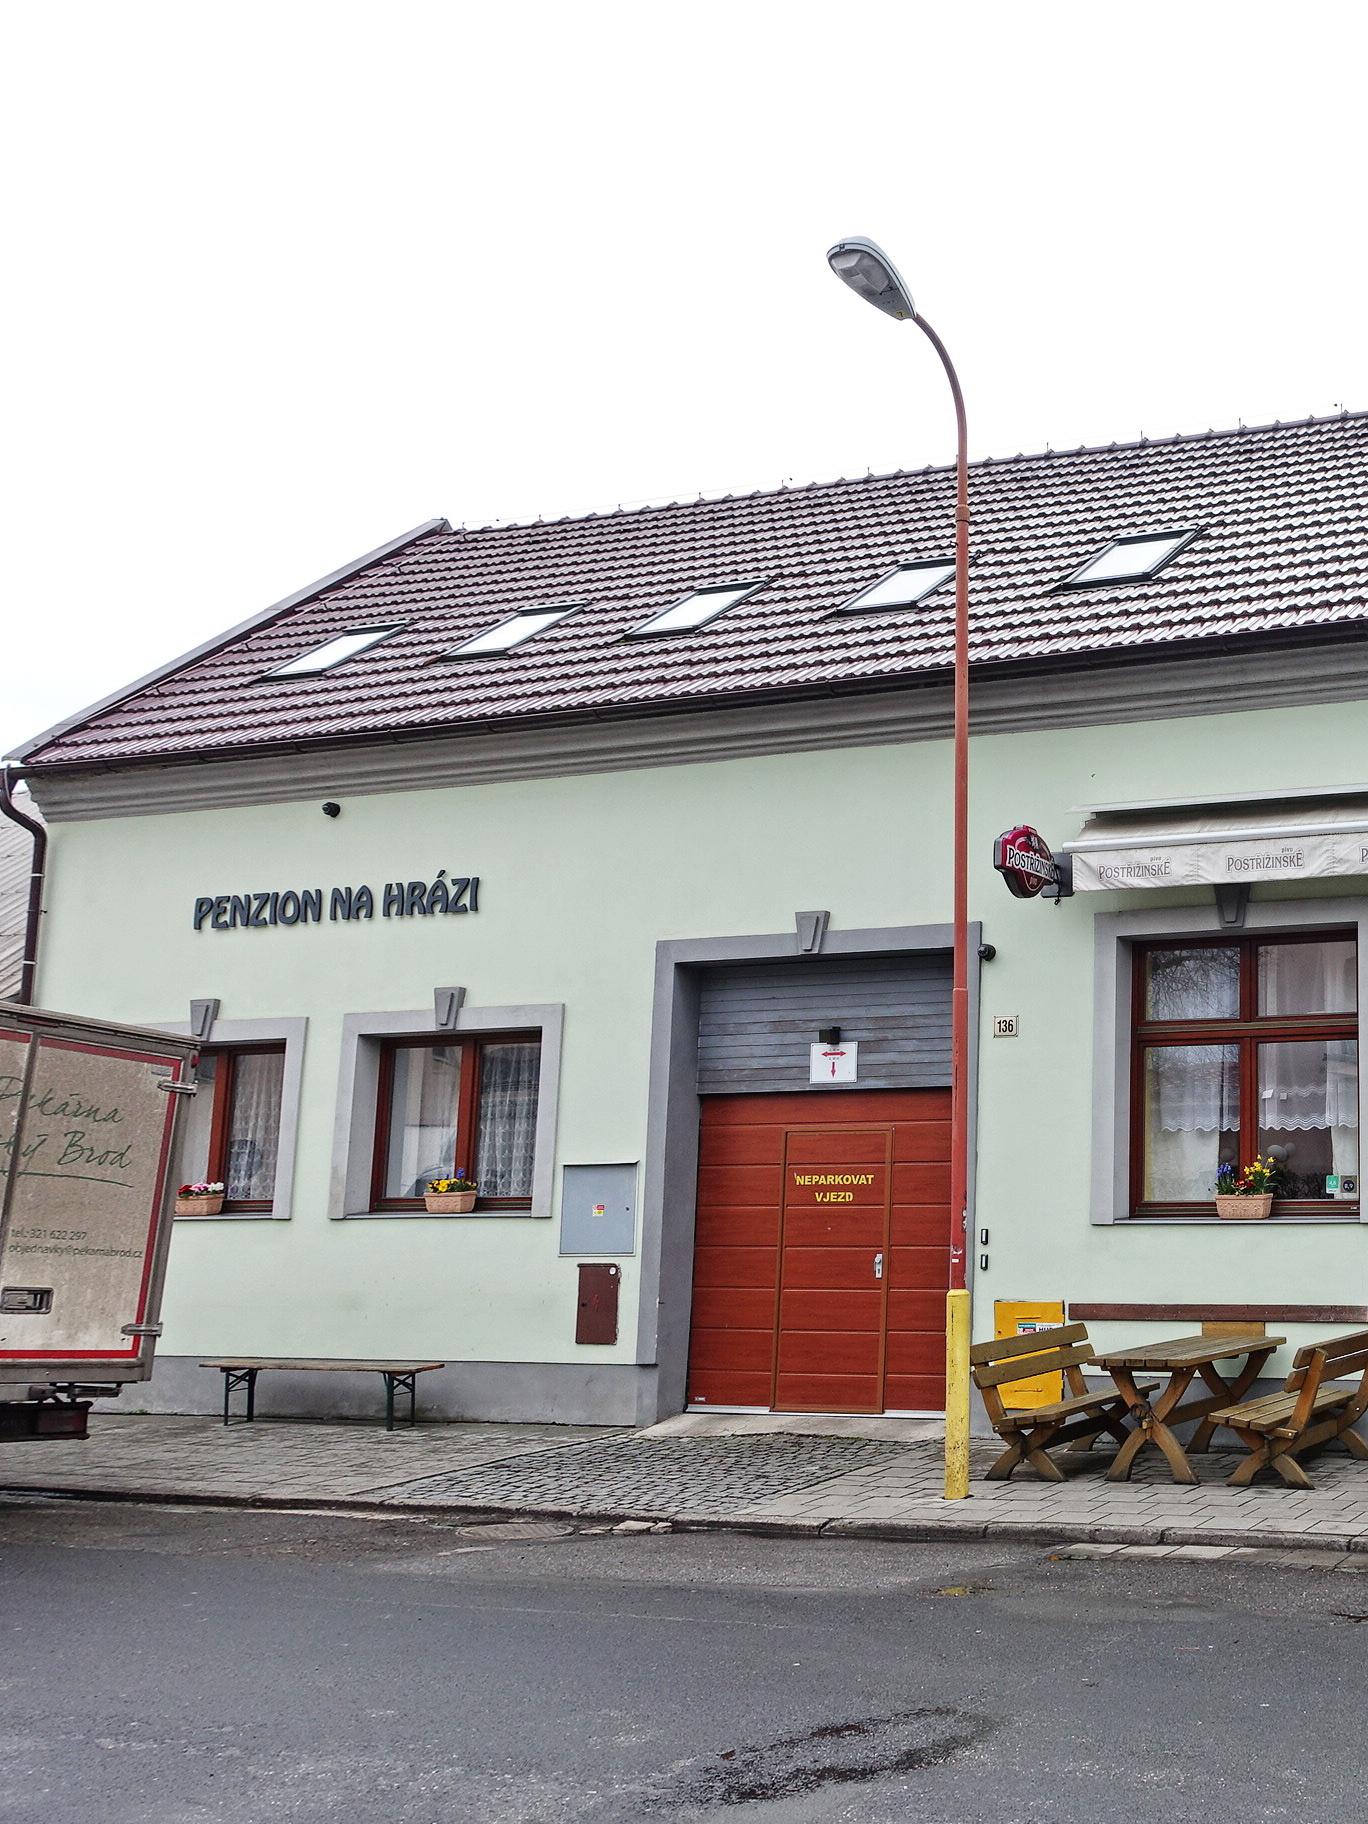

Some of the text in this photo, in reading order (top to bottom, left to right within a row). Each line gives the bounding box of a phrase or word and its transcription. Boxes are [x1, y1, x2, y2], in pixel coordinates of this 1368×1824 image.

[1099, 857, 1172, 880] POSTŘIŽINSKÉ
[1227, 849, 1304, 872] POSTŘIŽINSKÉ
[193, 869, 481, 931] PENZION NA HRÁZI
[997, 1019, 1014, 1033] 136
[57, 1130, 133, 1169] Brod
[795, 1174, 875, 1186] NEPARKOVAT
[815, 1191, 854, 1203] VJEZD
